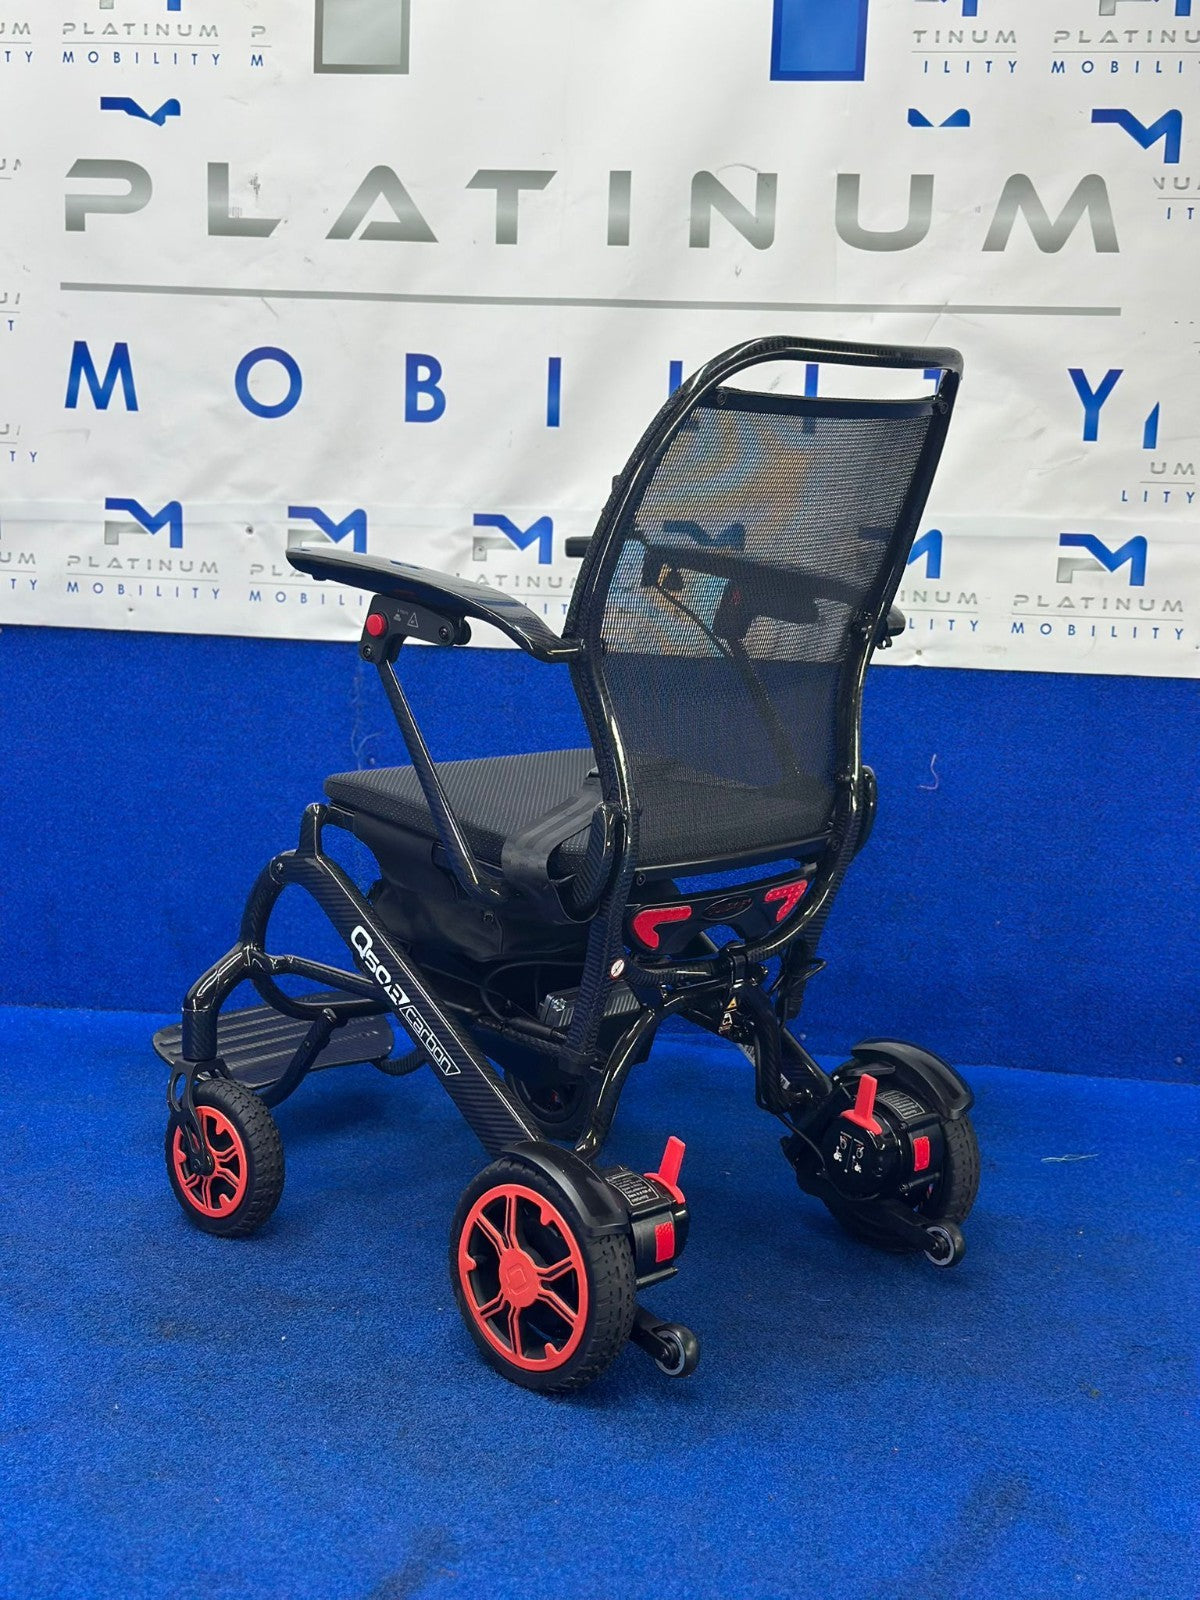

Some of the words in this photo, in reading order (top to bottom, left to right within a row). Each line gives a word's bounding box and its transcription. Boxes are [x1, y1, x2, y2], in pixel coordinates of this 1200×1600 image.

[63, 22, 219, 38] PLATINUM
[912, 29, 1017, 44] TINUM
[63, 50, 220, 66] MOBILITY
[923, 60, 1018, 74] ILITY
[1051, 60, 1200, 74] MOBILI
[1153, 177, 1200, 191] NU
[65, 157, 1120, 253] PLATINUM
[1150, 461, 1196, 476] UM
[1121, 489, 1196, 504] LITY
[67, 555, 219, 574] PLATINUM
[66, 581, 220, 600] MOBILITY
[1013, 594, 1184, 613] PLATINUM
[908, 617, 979, 632] LITY
[1011, 621, 1184, 641] MOBILITY
[405, 1007, 453, 1074] carbon
